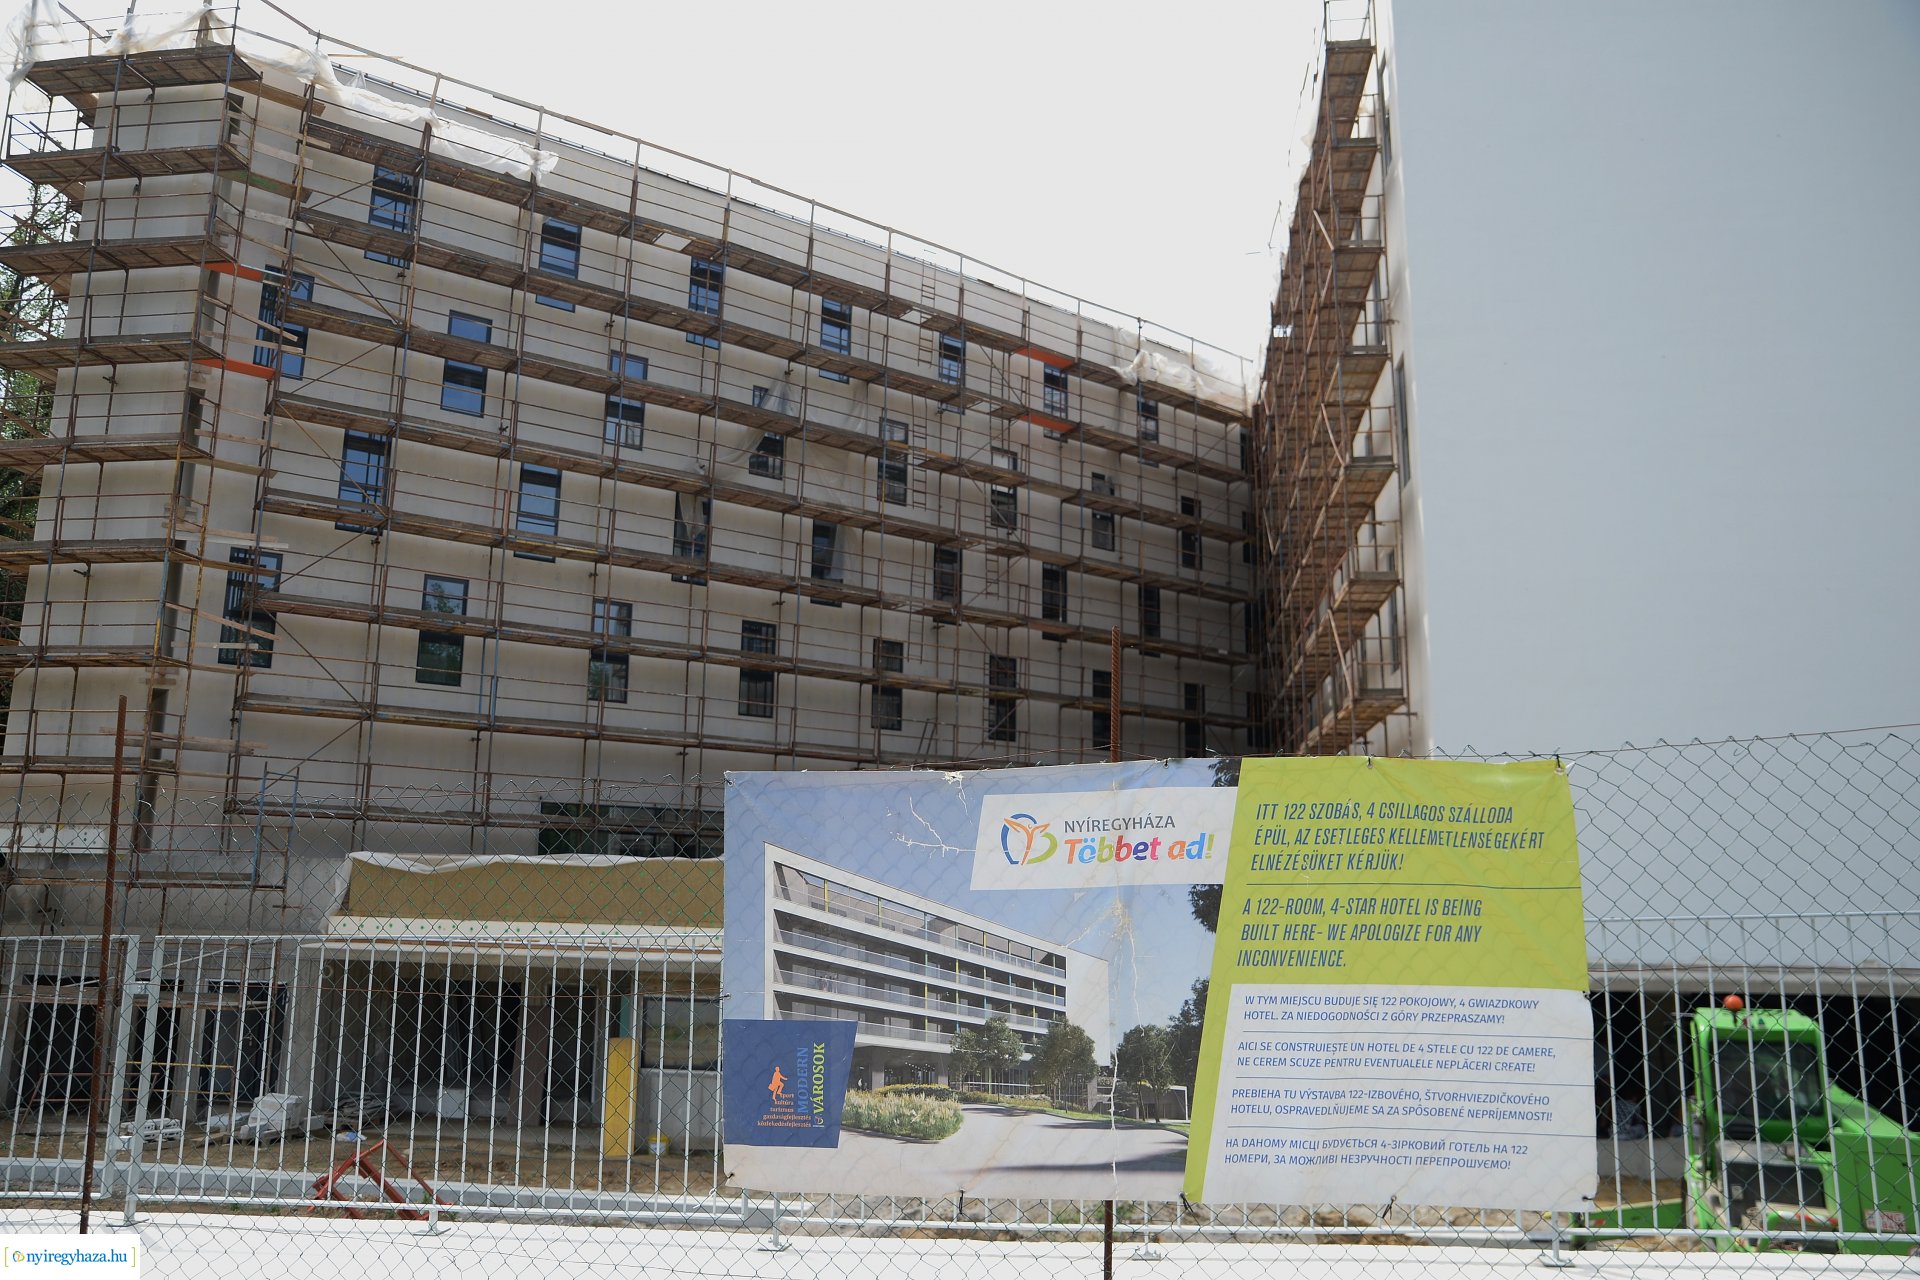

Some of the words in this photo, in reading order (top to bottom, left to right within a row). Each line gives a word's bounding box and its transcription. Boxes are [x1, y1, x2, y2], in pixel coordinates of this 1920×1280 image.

[1256, 803, 1278, 820] ITT
[1284, 803, 1306, 819] 122
[1309, 799, 1362, 821] SZOBÁS,
[1366, 802, 1375, 818] 4
[1379, 802, 1445, 821] CSILLAGOS
[1449, 803, 1513, 823] SZÁLLODA
[1064, 812, 1176, 833] NYÍREGYHÁZA
[1254, 825, 1290, 847] ÉPÜL,
[1295, 829, 1311, 845] AZ
[1314, 828, 1385, 845] ESETLEGES
[1389, 828, 1544, 849] KELLEMETLENSÉGEKÉRT
[1064, 835, 1161, 864] Többet
[1168, 833, 1215, 861] ad!
[1251, 850, 1343, 870] ELNÉZÉSÜKET
[1347, 849, 1404, 870] KÉRJÜK!
[1242, 898, 1251, 915] A
[1256, 898, 1326, 917] 122-ROOM,
[1331, 898, 1376, 915] 4-STAR
[1380, 898, 1421, 915] HOTEL
[1425, 899, 1437, 915] IS
[1442, 900, 1482, 917] BEING
[1241, 924, 1279, 941] BUILT
[1283, 924, 1323, 941] HERE-
[1328, 924, 1347, 941] WE
[1350, 924, 1421, 941] APOLOGIZE
[1425, 925, 1451, 941] FOR
[1455, 925, 1482, 942] ANY
[1237, 950, 1346, 967] INCONVENIENCE.
[1245, 996, 1254, 1005] W
[1257, 996, 1277, 1005] TYM
[1280, 996, 1322, 1006] MIEJSCU
[1325, 996, 1360, 1006] BUDUJE
[1363, 997, 1378, 1008] SIĘ
[1382, 997, 1397, 1006] 122
[1400, 997, 1457, 1009] POKOJOWY,
[1460, 999, 1465, 1007] 4
[1468, 999, 1539, 1009] GWIAZDKOWY
[1244, 1011, 1278, 1020] HOTEL.
[1281, 1012, 1294, 1020] ZA
[1296, 1010, 1379, 1021] NIEDOGODNOŚCI
[1382, 1012, 1388, 1021] Z
[1391, 1010, 1419, 1021] GÓRY
[1421, 1013, 1505, 1024] PRZEPRASZAMY!
[1238, 1042, 1257, 1051] AICI
[1260, 1042, 1272, 1051] SE
[1351, 1043, 1364, 1051] UN
[1368, 1043, 1399, 1053] HOTEL
[1403, 1044, 1416, 1053] DE
[1418, 1044, 1424, 1053] 4
[1427, 1044, 1457, 1054] STELE
[1460, 1045, 1474, 1054] CU
[1478, 1046, 1492, 1055] 122
[1496, 1046, 1509, 1056] DE
[1512, 1047, 1556, 1058] CAMERE,
[1237, 1057, 1250, 1066] NE
[1253, 1057, 1287, 1066] CEREM
[1290, 1058, 1321, 1067] SCUZE
[1325, 1058, 1361, 1067] PENTRU
[1364, 1058, 1433, 1068] EVENTUALELE
[1436, 1059, 1492, 1071] NEPLĂCERI
[1495, 1062, 1535, 1072] CREATE!
[796, 1048, 808, 1113] MODERN
[810, 1043, 824, 1113] VÁROSOK
[1232, 1089, 1280, 1099] PREBIEHA
[1284, 1090, 1297, 1099] TU
[1300, 1088, 1345, 1100] VÝSTAVBA
[1349, 1089, 1421, 1101] 122-IZBOVÉHO,
[1425, 1090, 1550, 1106] ŠTVORHVIEZDIČKOVÉHO
[1231, 1104, 1272, 1115] HOTELU,
[1275, 1104, 1369, 1116] OSPRAVEDLŇUJEME
[1372, 1106, 1384, 1115] SA
[1387, 1106, 1399, 1115] ZA
[1402, 1105, 1465, 1117] SPÔSOBENÉ
[1467, 1108, 1552, 1121] NEPRÍJEMNOSTI!
